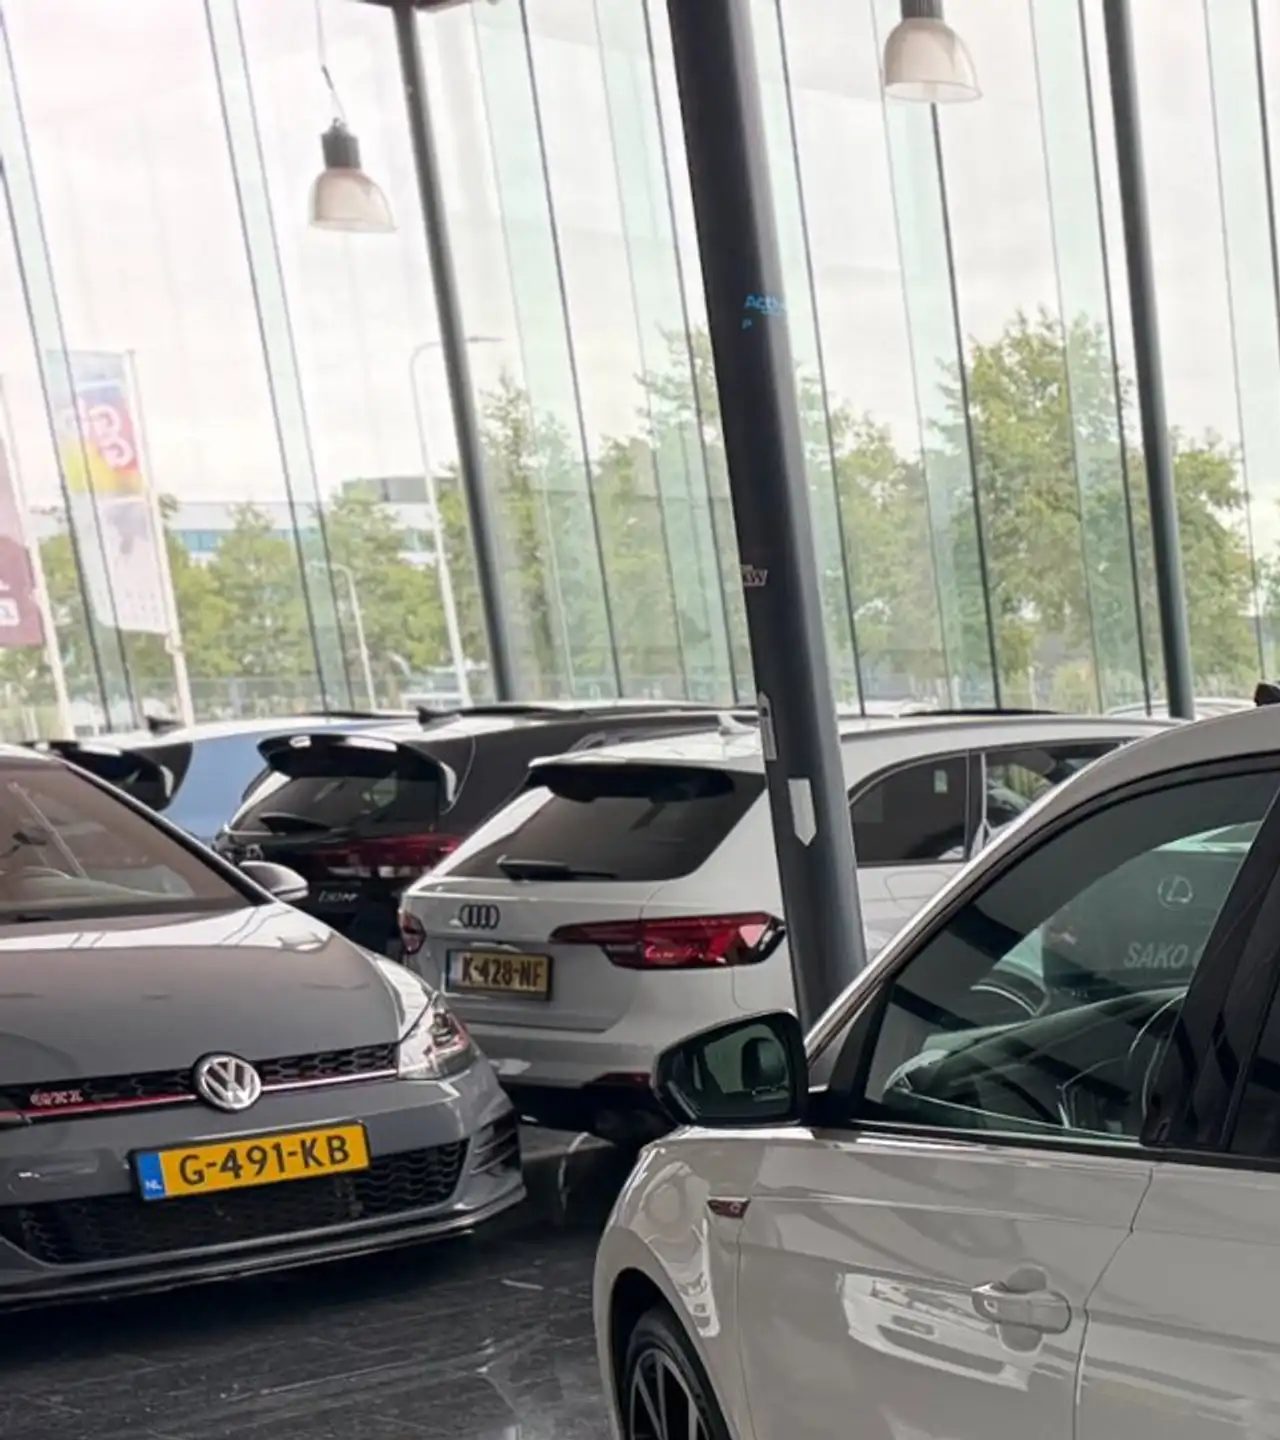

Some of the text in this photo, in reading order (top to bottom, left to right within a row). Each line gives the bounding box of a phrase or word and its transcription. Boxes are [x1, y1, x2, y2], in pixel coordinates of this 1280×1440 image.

[1123, 941, 1188, 969] SAKO
[461, 956, 544, 987] K-428-NF
[178, 1134, 350, 1187] G-491-KB
